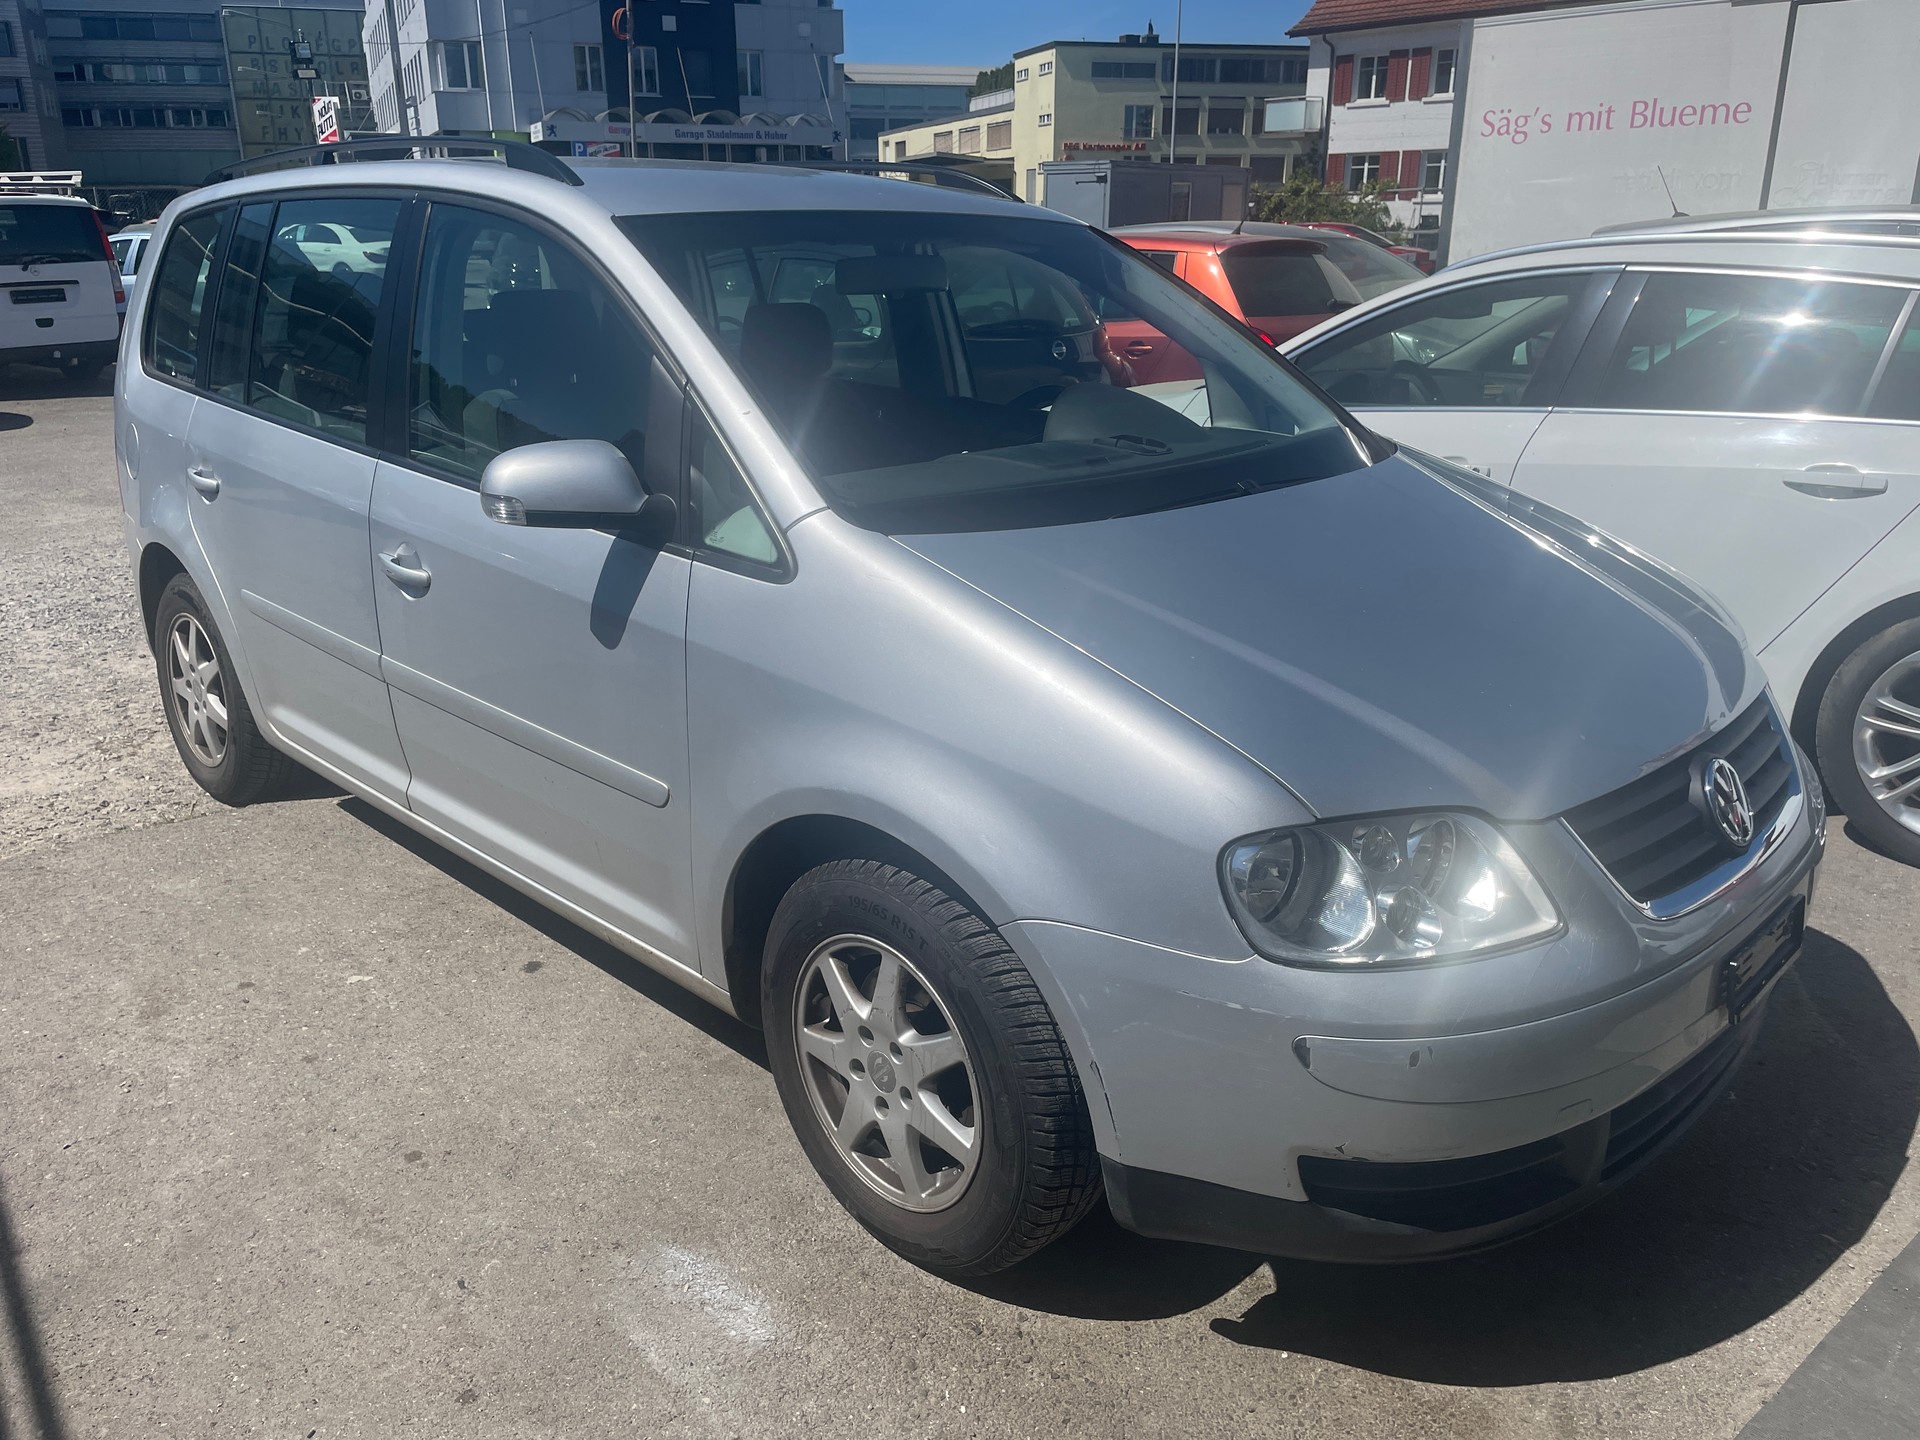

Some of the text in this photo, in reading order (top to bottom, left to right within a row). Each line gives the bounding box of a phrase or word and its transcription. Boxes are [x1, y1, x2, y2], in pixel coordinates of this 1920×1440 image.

[674, 129, 788, 140] Garage Stadelmann & Huber
[1479, 97, 1752, 145] Säg's mit Blueme
[848, 895, 929, 951] 195/65 R15 T
